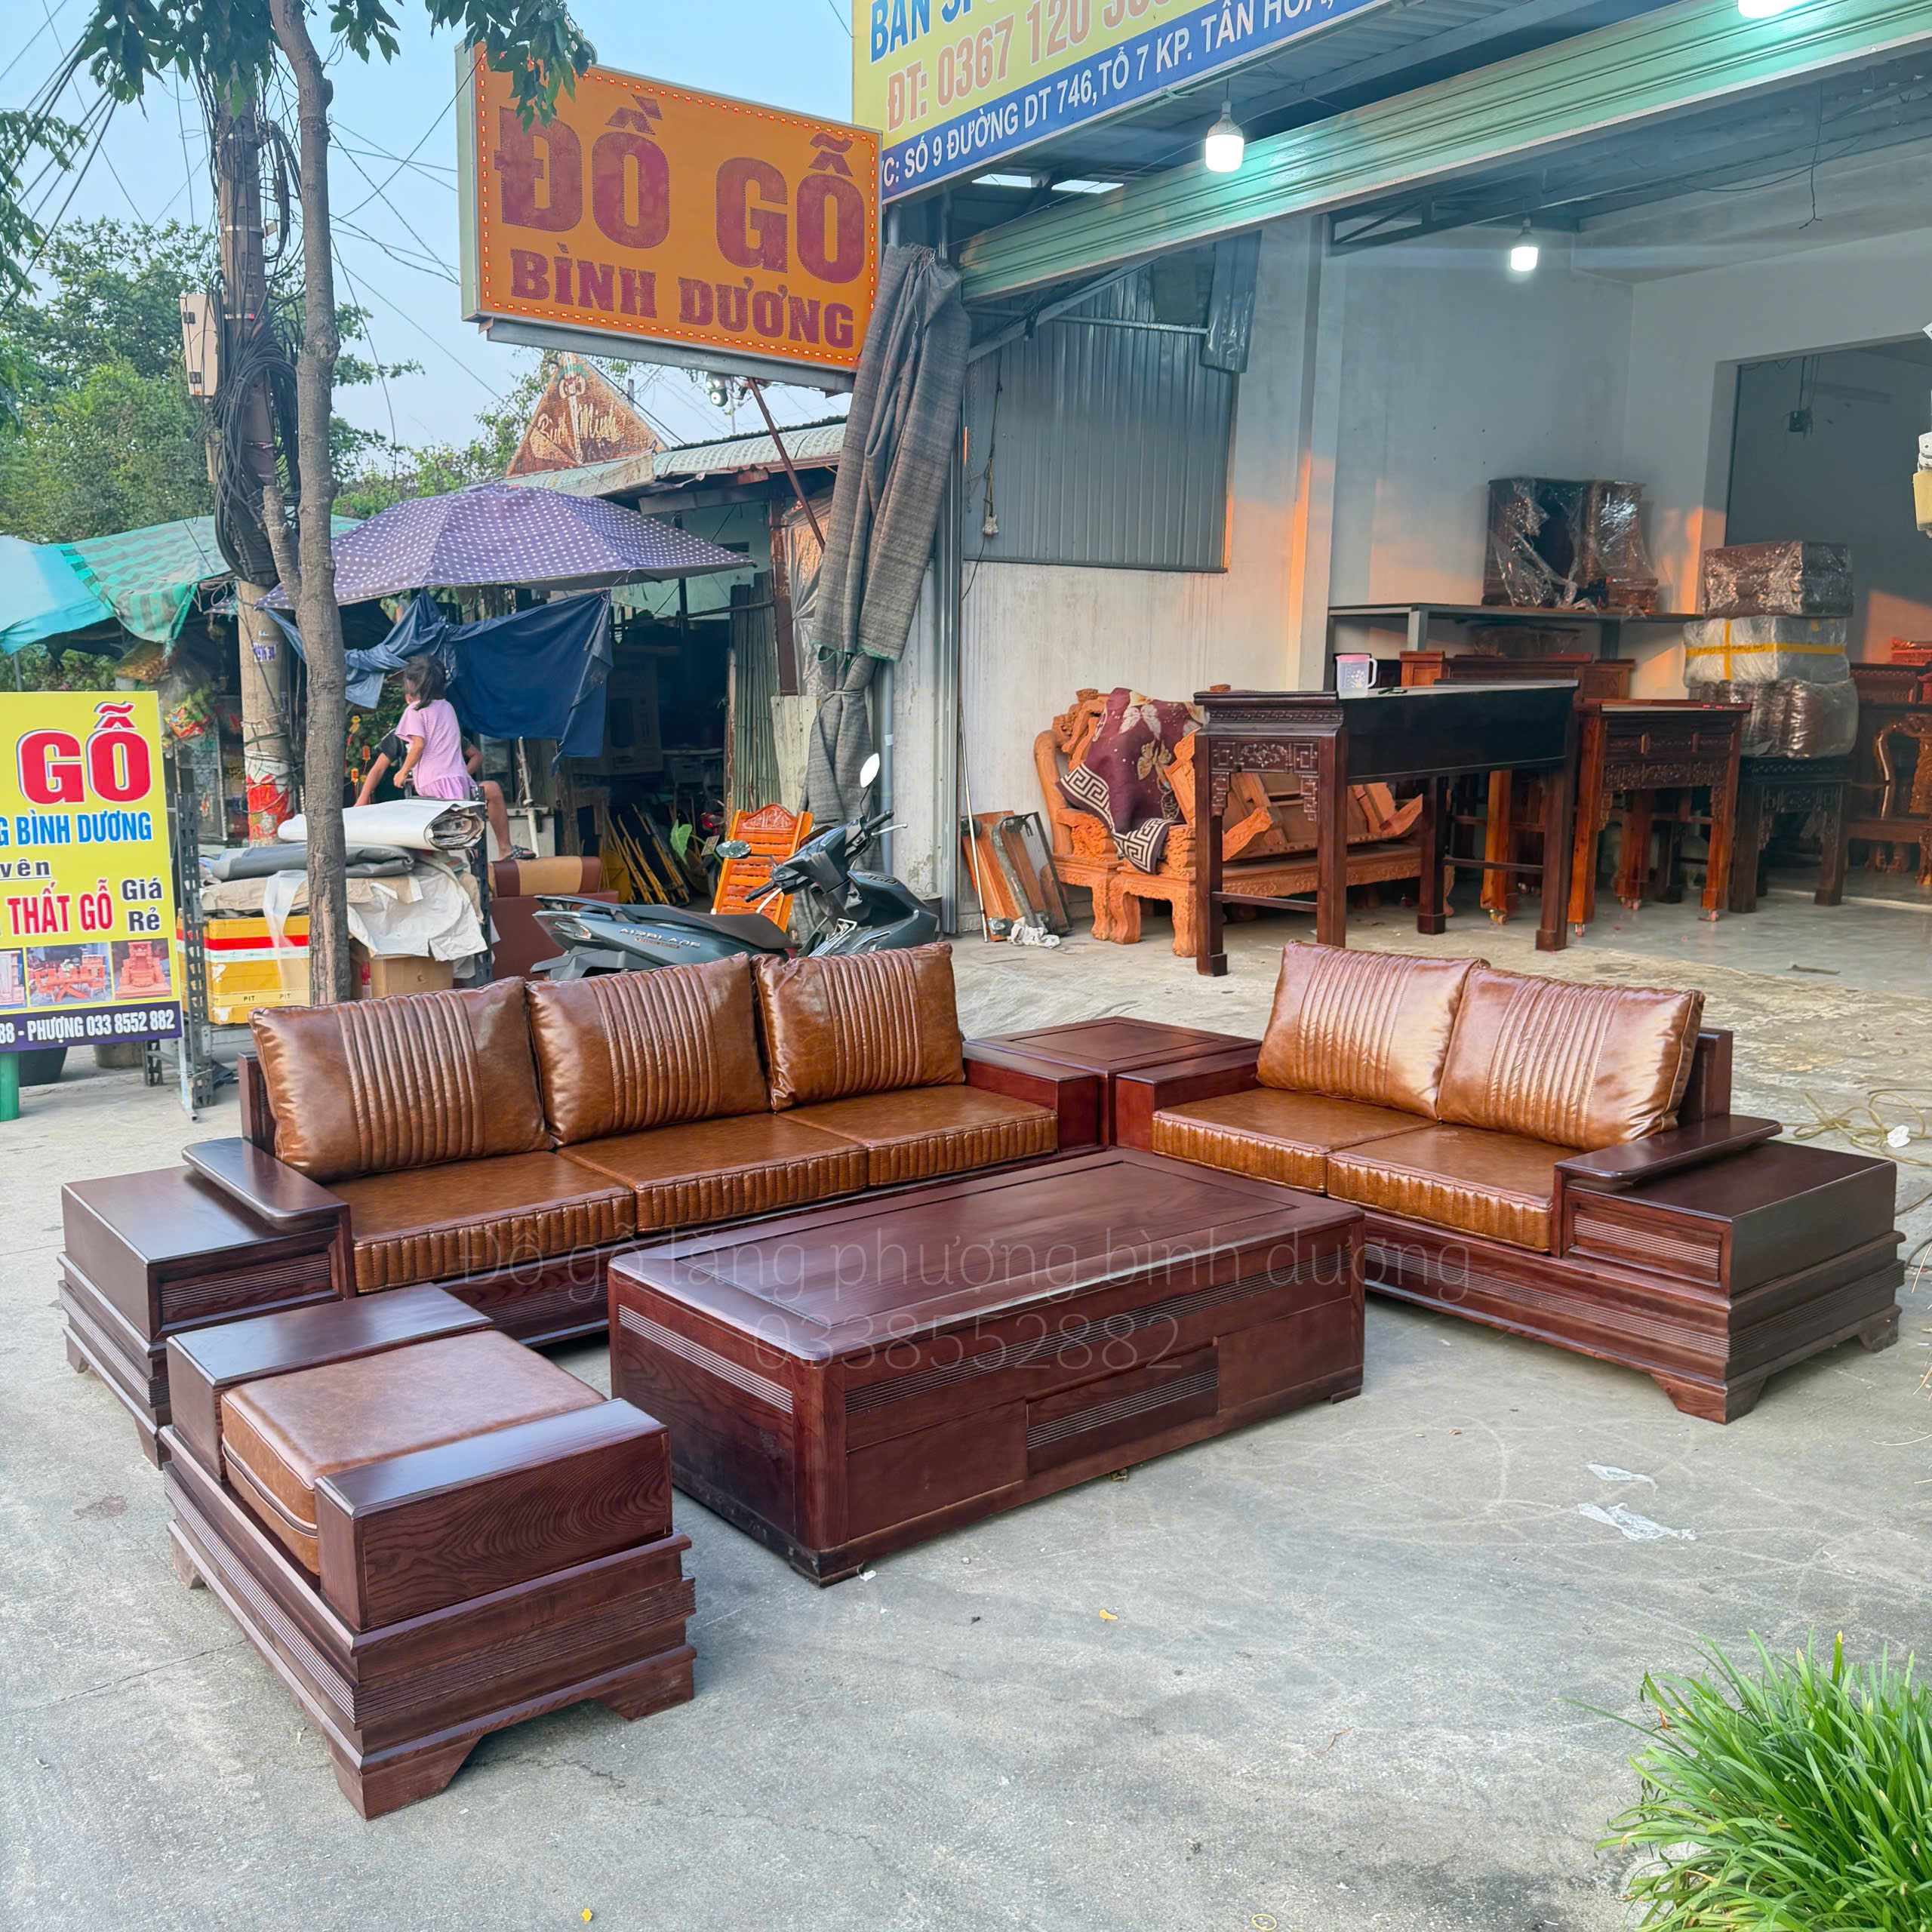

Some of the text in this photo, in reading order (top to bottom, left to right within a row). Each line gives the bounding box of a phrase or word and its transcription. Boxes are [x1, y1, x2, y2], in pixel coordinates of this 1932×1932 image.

[888, 61, 927, 131] ĐT:
[938, 14, 1014, 106] 0367
[1027, 0, 1091, 65] 120
[905, 136, 928, 178] SỐ
[933, 136, 942, 167] 9
[946, 103, 1018, 161] ĐƯỜNG
[1025, 87, 1051, 128] DT
[1137, 44, 1149, 81] 7
[1156, 27, 1192, 72] KP.
[1201, 1, 1254, 53] TÂN
[494, 94, 866, 284] ĐỒ GỖ
[509, 242, 854, 349] BÌNH DƯƠNG
[17, 701, 151, 804] GỖ
[16, 810, 71, 845] BÌNH
[77, 810, 152, 843] DƯƠNG
[7, 878, 112, 935] THẤT GỖ
[122, 878, 162, 900] Giá
[128, 907, 160, 931] Rẻ
[26, 1016, 85, 1043] PHƯỢNG
[87, 1014, 112, 1036] 033
[115, 1011, 148, 1033] 8552
[149, 1009, 175, 1030] 882
